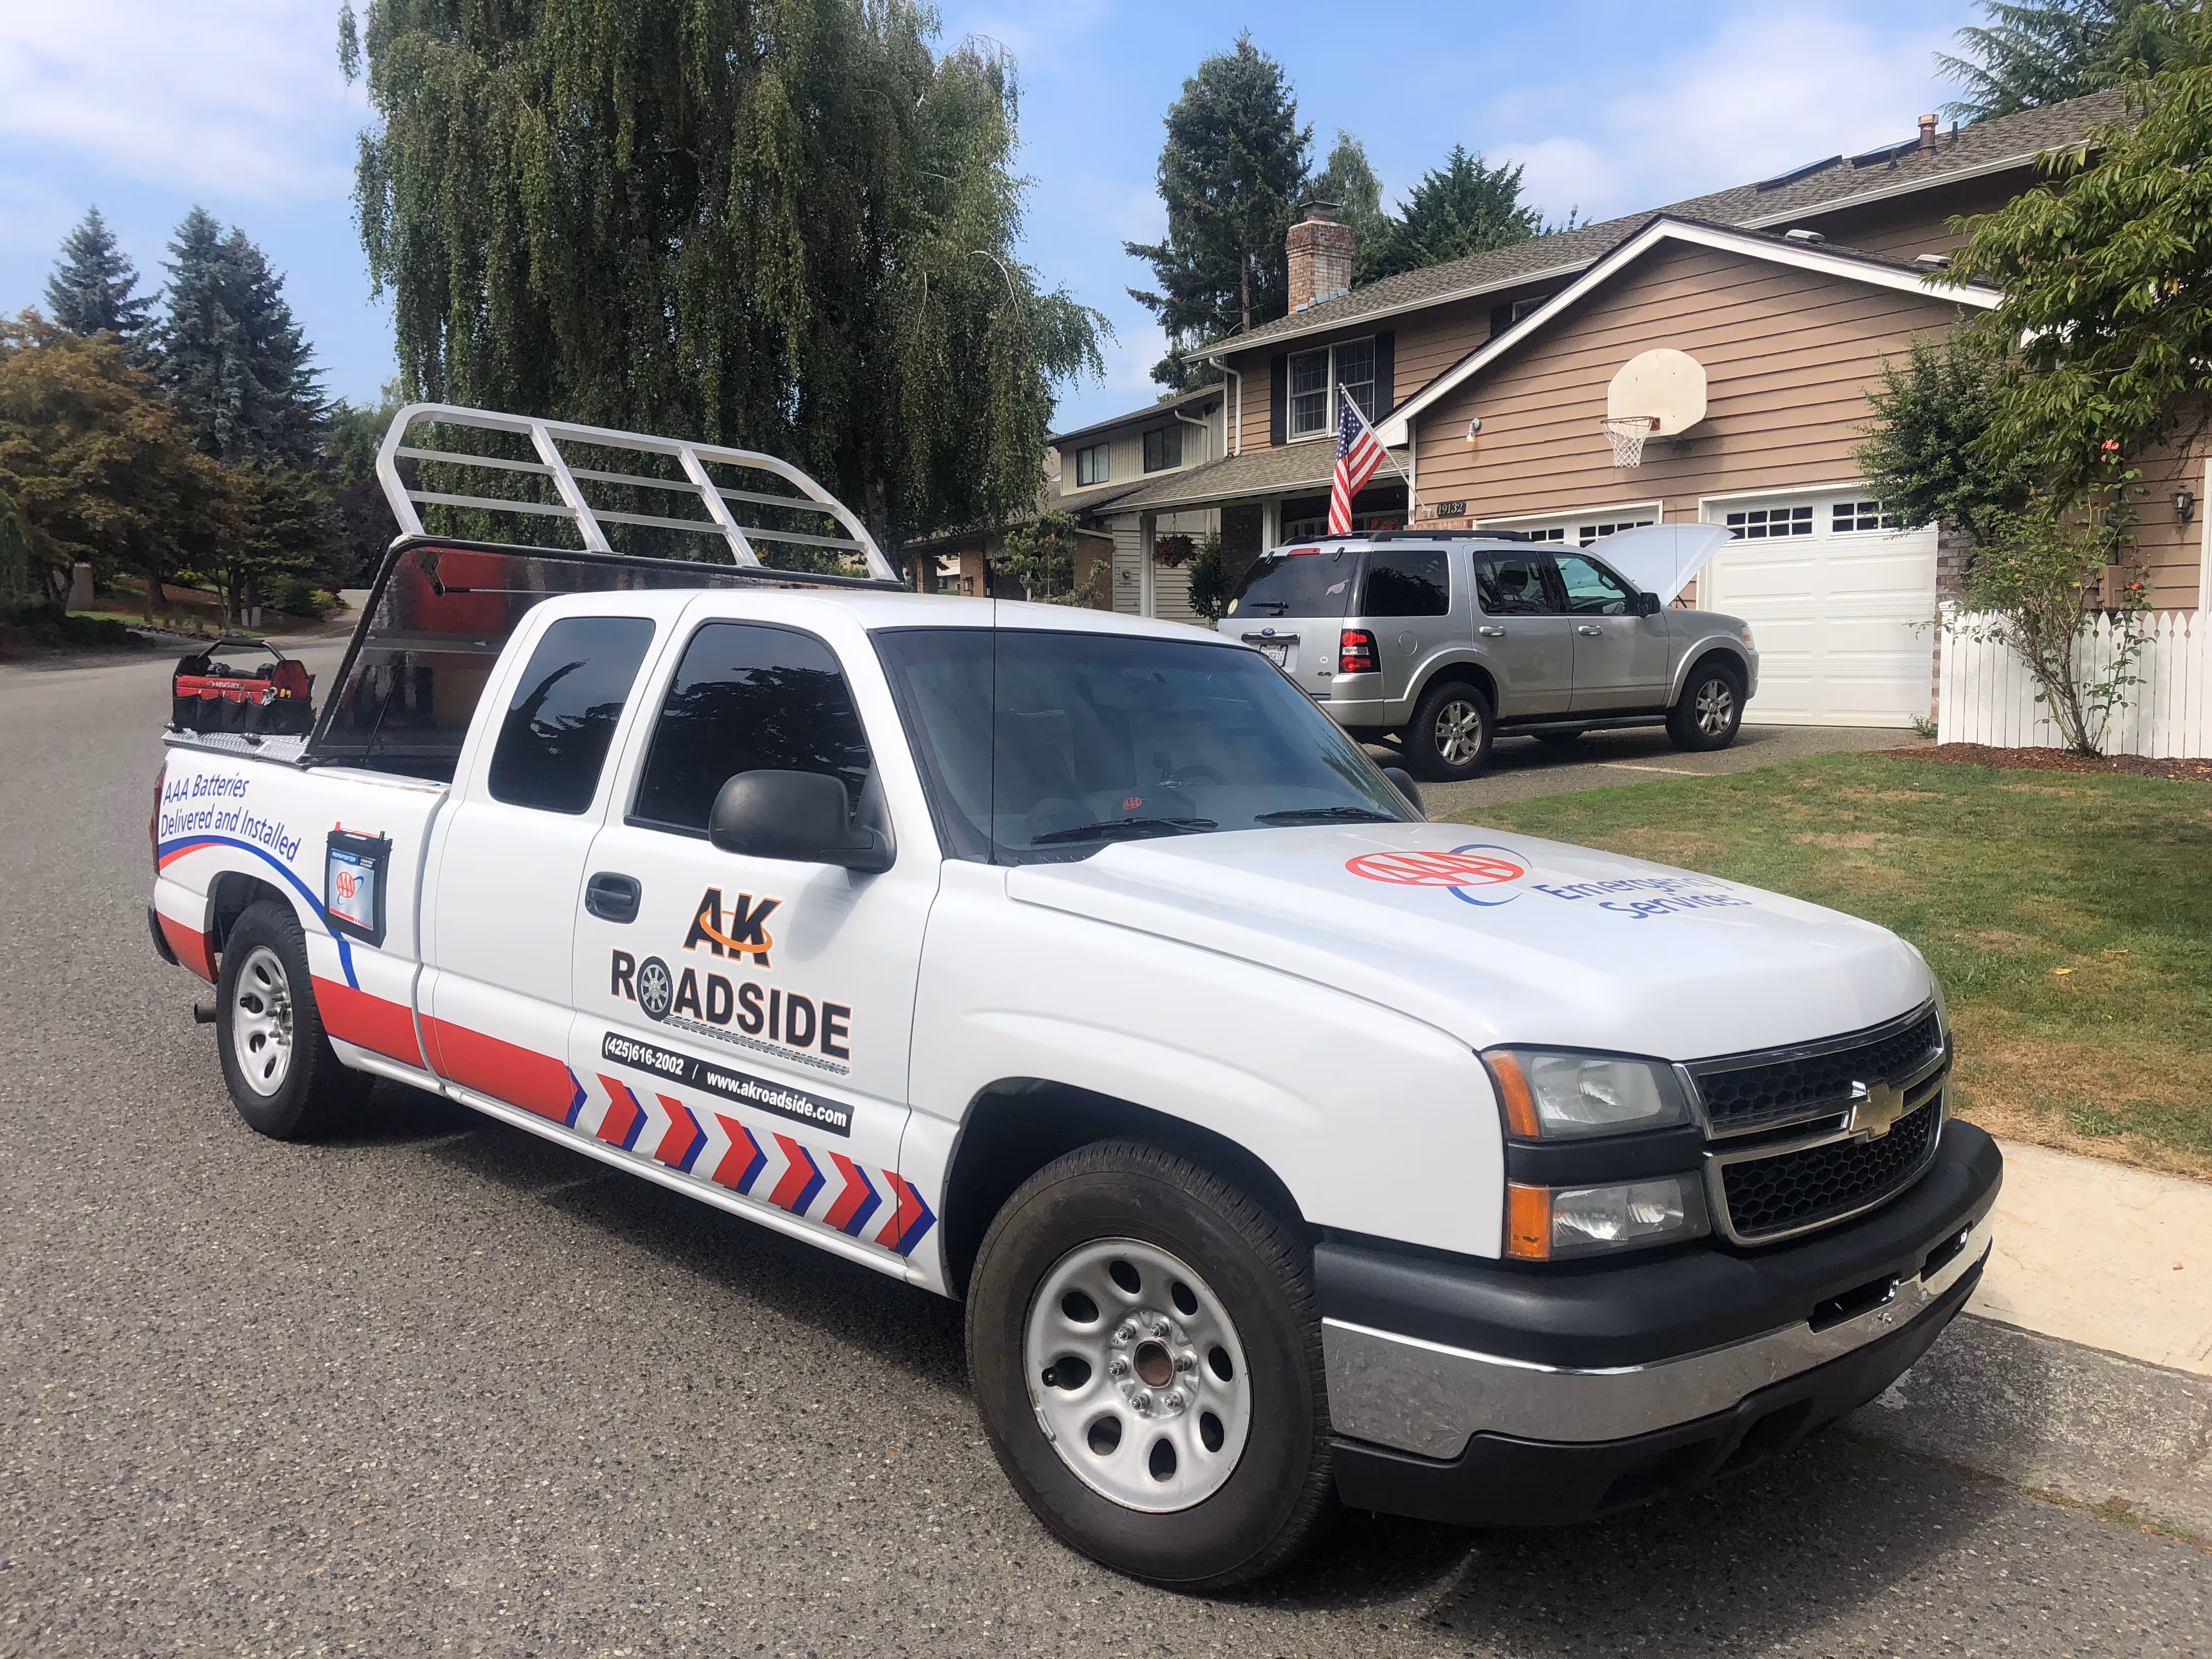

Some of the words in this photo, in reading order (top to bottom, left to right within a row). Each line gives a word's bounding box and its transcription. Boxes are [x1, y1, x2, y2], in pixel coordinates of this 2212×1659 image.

[1438, 502, 1463, 515] 19132
[163, 777, 189, 806] AAA
[192, 772, 250, 798] Batteries
[161, 803, 216, 838] Delivered
[215, 806, 242, 832] and
[240, 810, 301, 863] Installed
[336, 871, 356, 899] AAA
[1345, 851, 1525, 887] AAA
[1530, 877, 1734, 900] Emergency
[1598, 894, 1754, 919] Services
[682, 887, 783, 969] AK
[605, 1035, 685, 1076] (425)616-2002
[707, 1070, 848, 1128] www.akroadside.com
